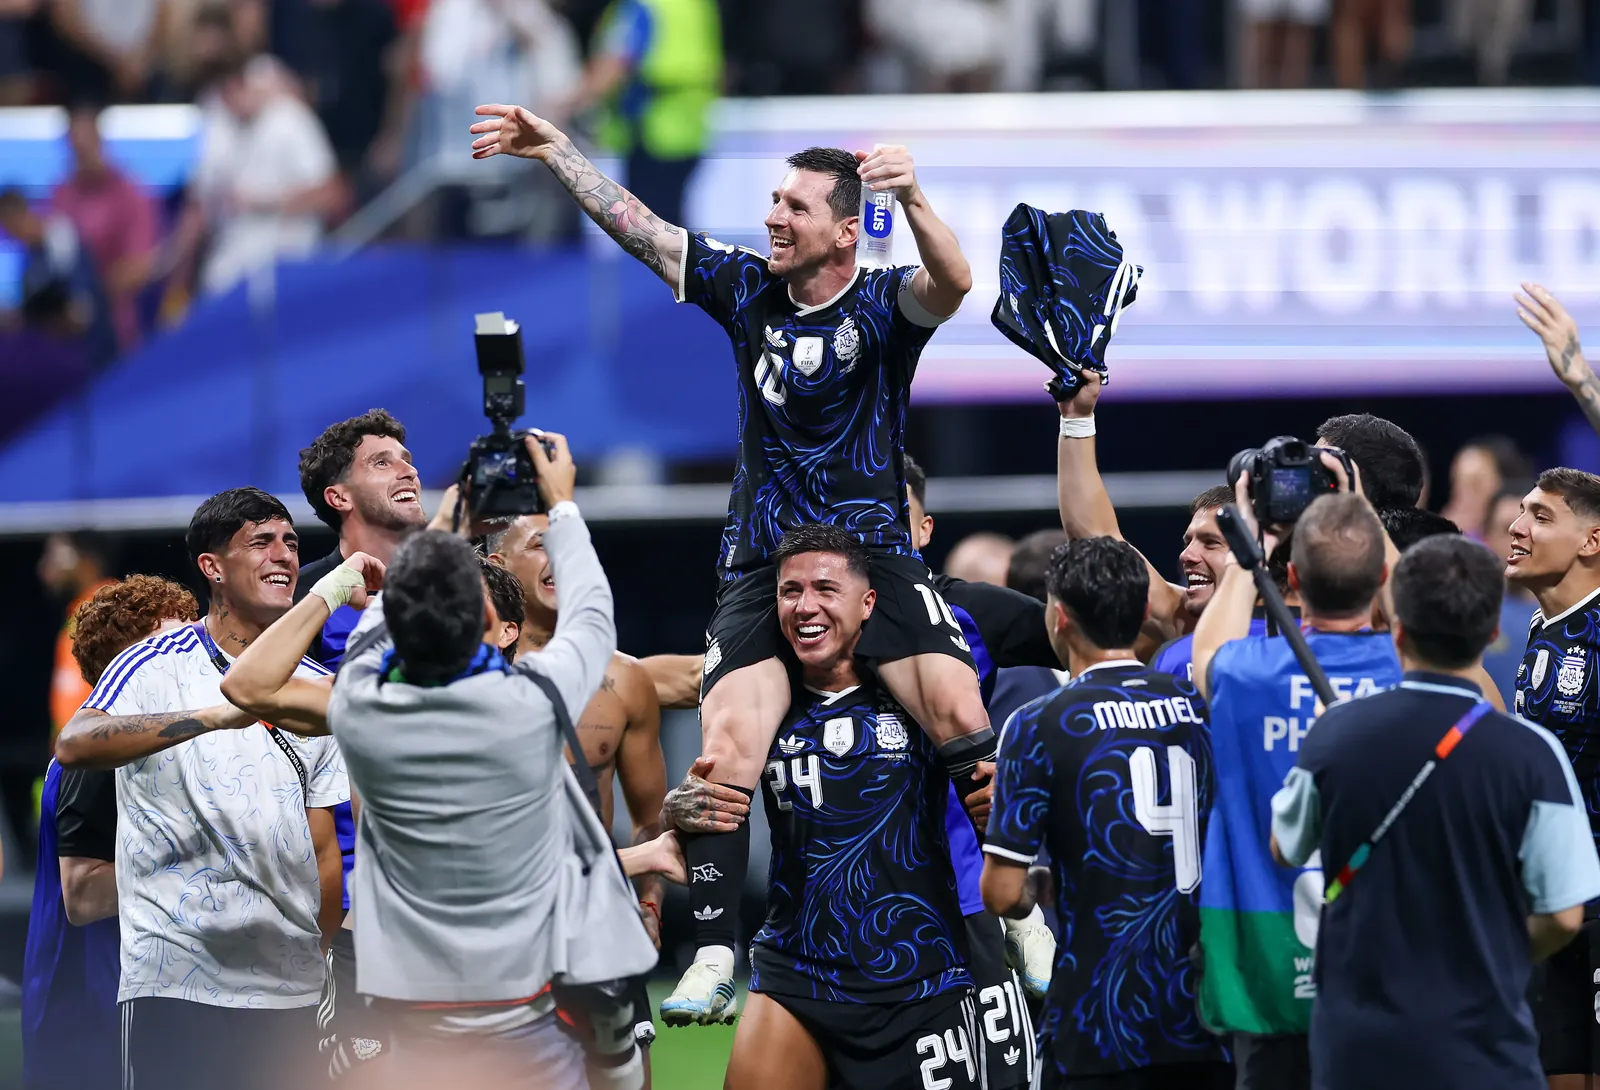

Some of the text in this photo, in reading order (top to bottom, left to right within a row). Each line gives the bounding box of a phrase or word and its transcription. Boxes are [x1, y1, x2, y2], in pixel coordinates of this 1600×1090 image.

[1174, 174, 1600, 316] WORLD
[1092, 696, 1204, 731] MONTIEL
[274, 733, 288, 750] FIFA
[286, 747, 302, 773] WORLD
[765, 752, 824, 812] 24
[1128, 744, 1203, 895] 4
[979, 980, 1021, 1044] 21
[915, 1025, 976, 1090] 24
